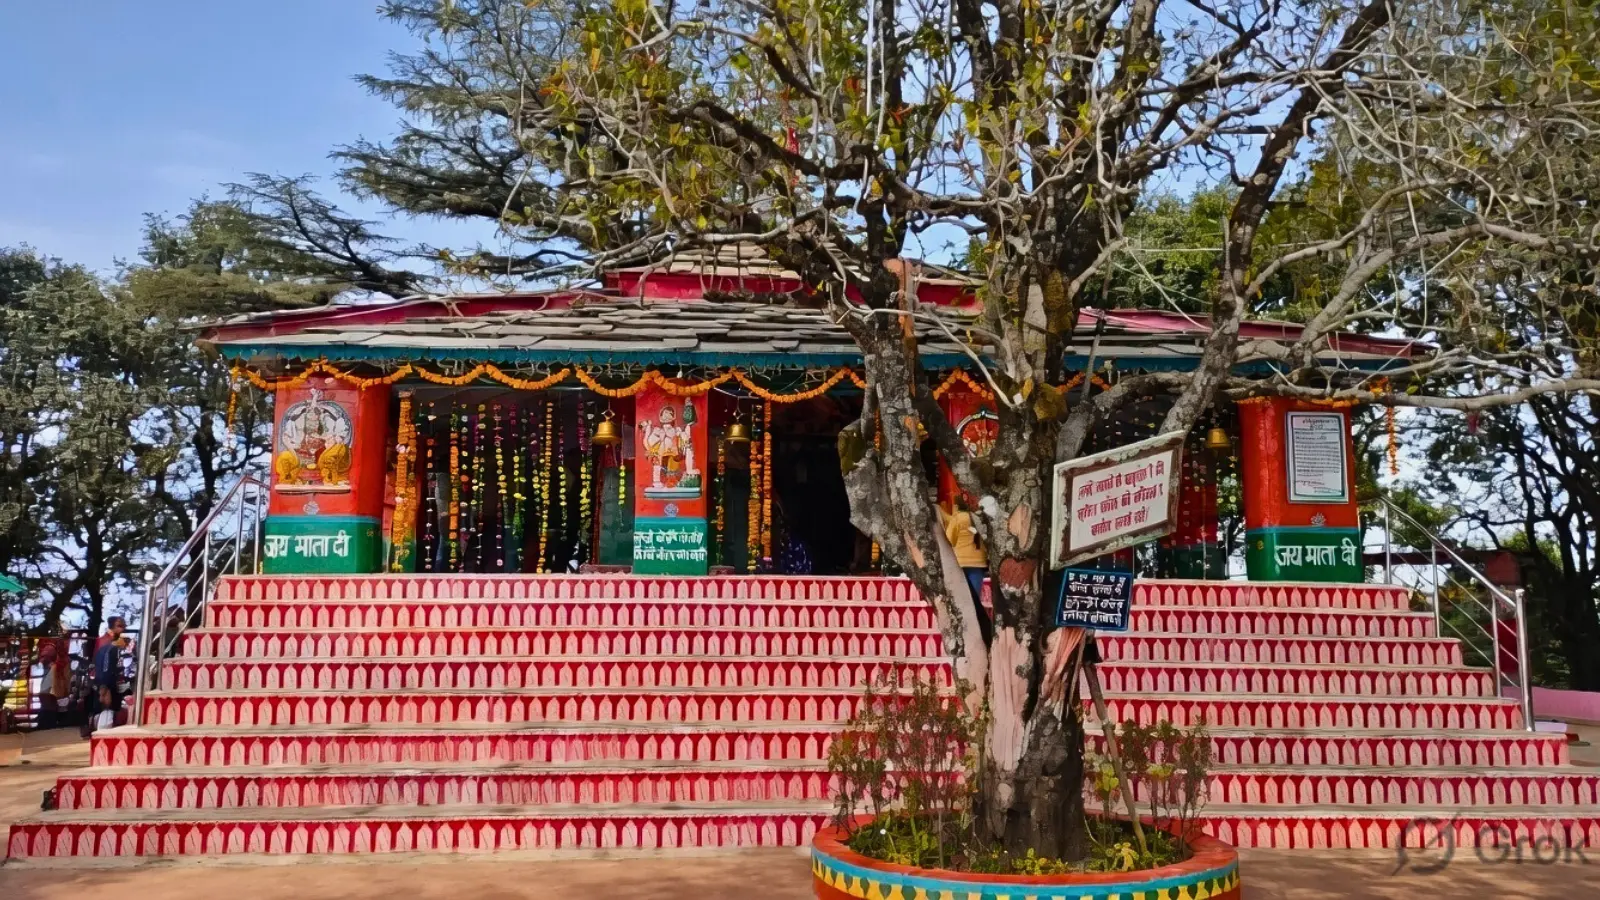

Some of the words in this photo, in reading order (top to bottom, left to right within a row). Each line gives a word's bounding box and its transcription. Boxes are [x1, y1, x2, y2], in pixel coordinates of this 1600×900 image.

[264, 535, 291, 558] जय
[294, 534, 330, 558] माता
[333, 529, 352, 557] दी
[1274, 545, 1303, 567] जय
[1305, 545, 1338, 567] माता
[1341, 537, 1357, 567] दी
